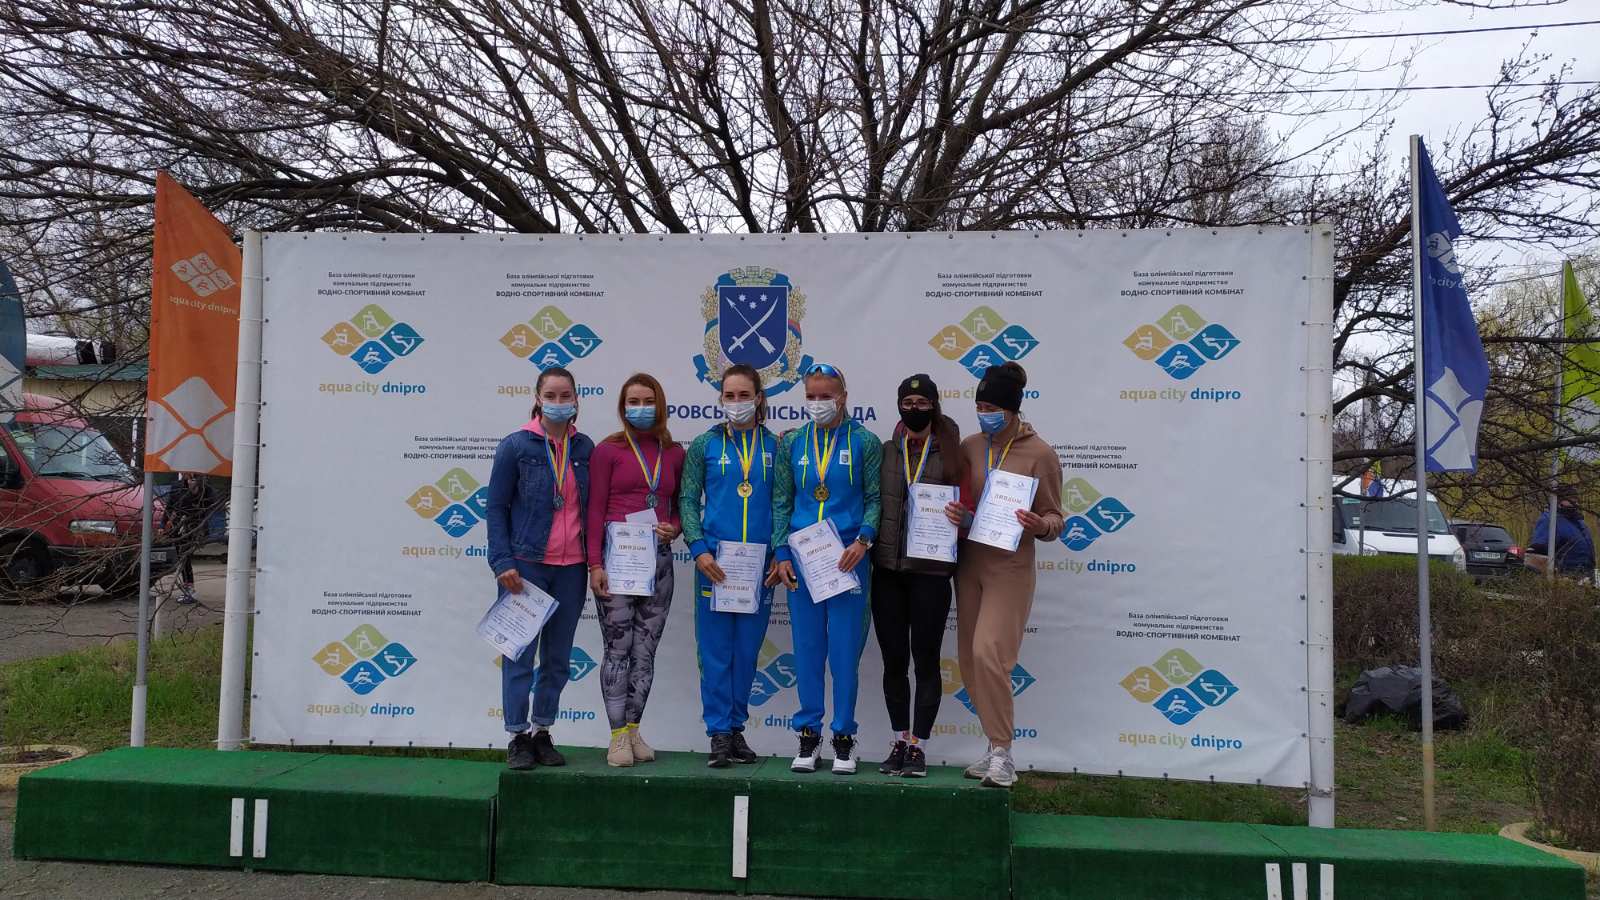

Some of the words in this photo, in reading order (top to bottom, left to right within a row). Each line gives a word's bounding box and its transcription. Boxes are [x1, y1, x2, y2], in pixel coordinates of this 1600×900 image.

[319, 383, 352, 395] aqua
[355, 381, 379, 396] city
[382, 381, 426, 396] dnipro
[497, 384, 530, 397] aqua
[578, 384, 604, 397] ipro
[1120, 390, 1156, 402] aqua
[1160, 388, 1186, 402] city
[1190, 387, 1241, 402] dnipro
[667, 405, 724, 419] РОВСЬ
[402, 546, 436, 558] aqua
[438, 544, 462, 558] city
[465, 545, 486, 556] dni
[1056, 558, 1084, 574] city
[1087, 560, 1136, 574] dnipro
[307, 704, 340, 716] aqua
[343, 702, 368, 717] city
[370, 702, 415, 718] dnipro
[933, 724, 957, 736] qua
[1118, 733, 1156, 747] aqua
[1160, 732, 1186, 749] city
[1191, 734, 1242, 750] dnipro
